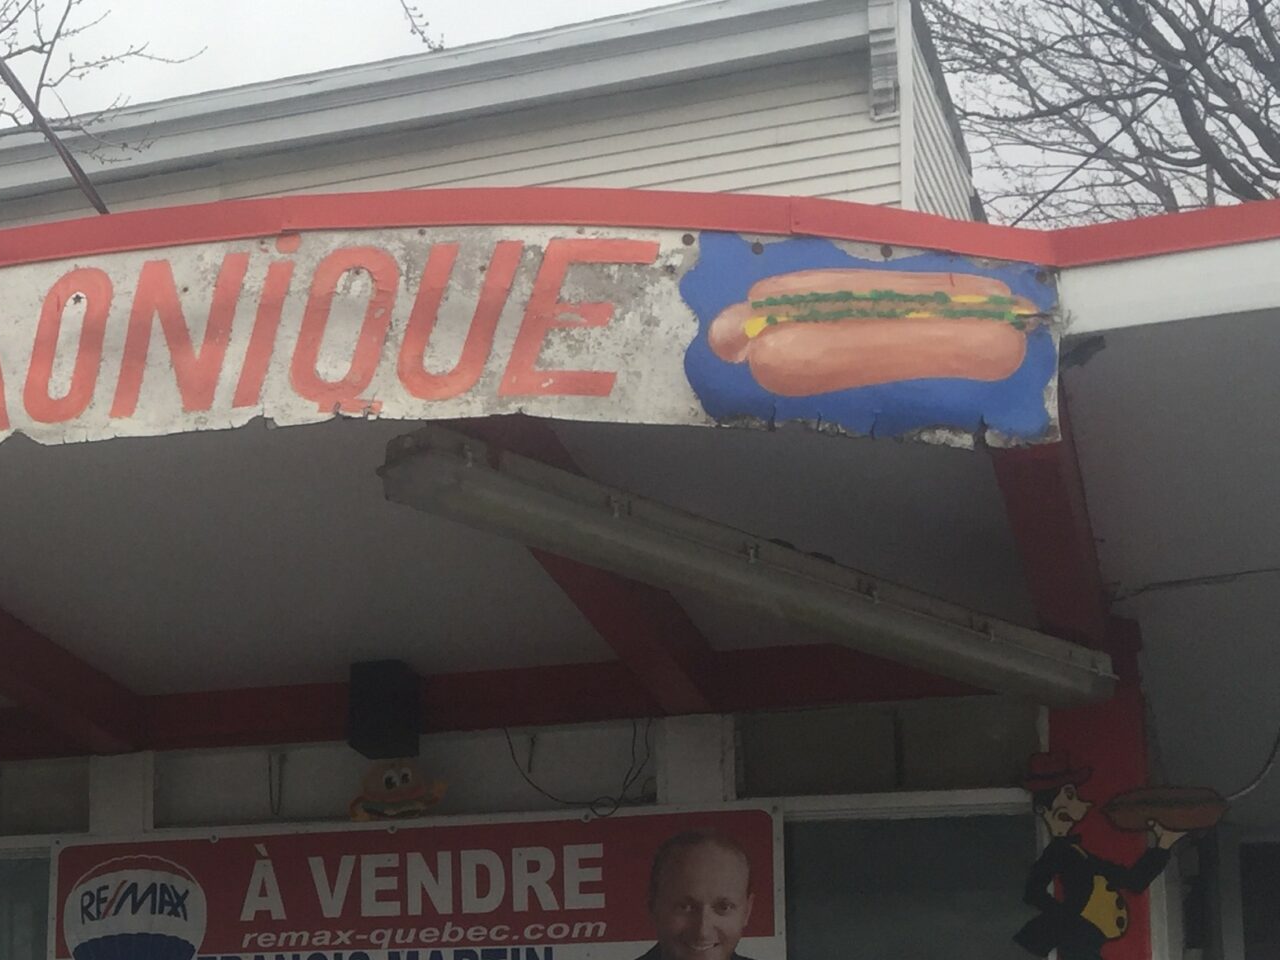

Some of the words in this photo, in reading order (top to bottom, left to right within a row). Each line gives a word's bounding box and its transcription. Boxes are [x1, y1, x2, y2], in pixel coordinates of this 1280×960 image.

[80, 879, 190, 925] RE/MAX
[239, 843, 288, 922] À
[307, 842, 606, 919] VENDRE
[241, 921, 607, 949] remax-quebec.com
